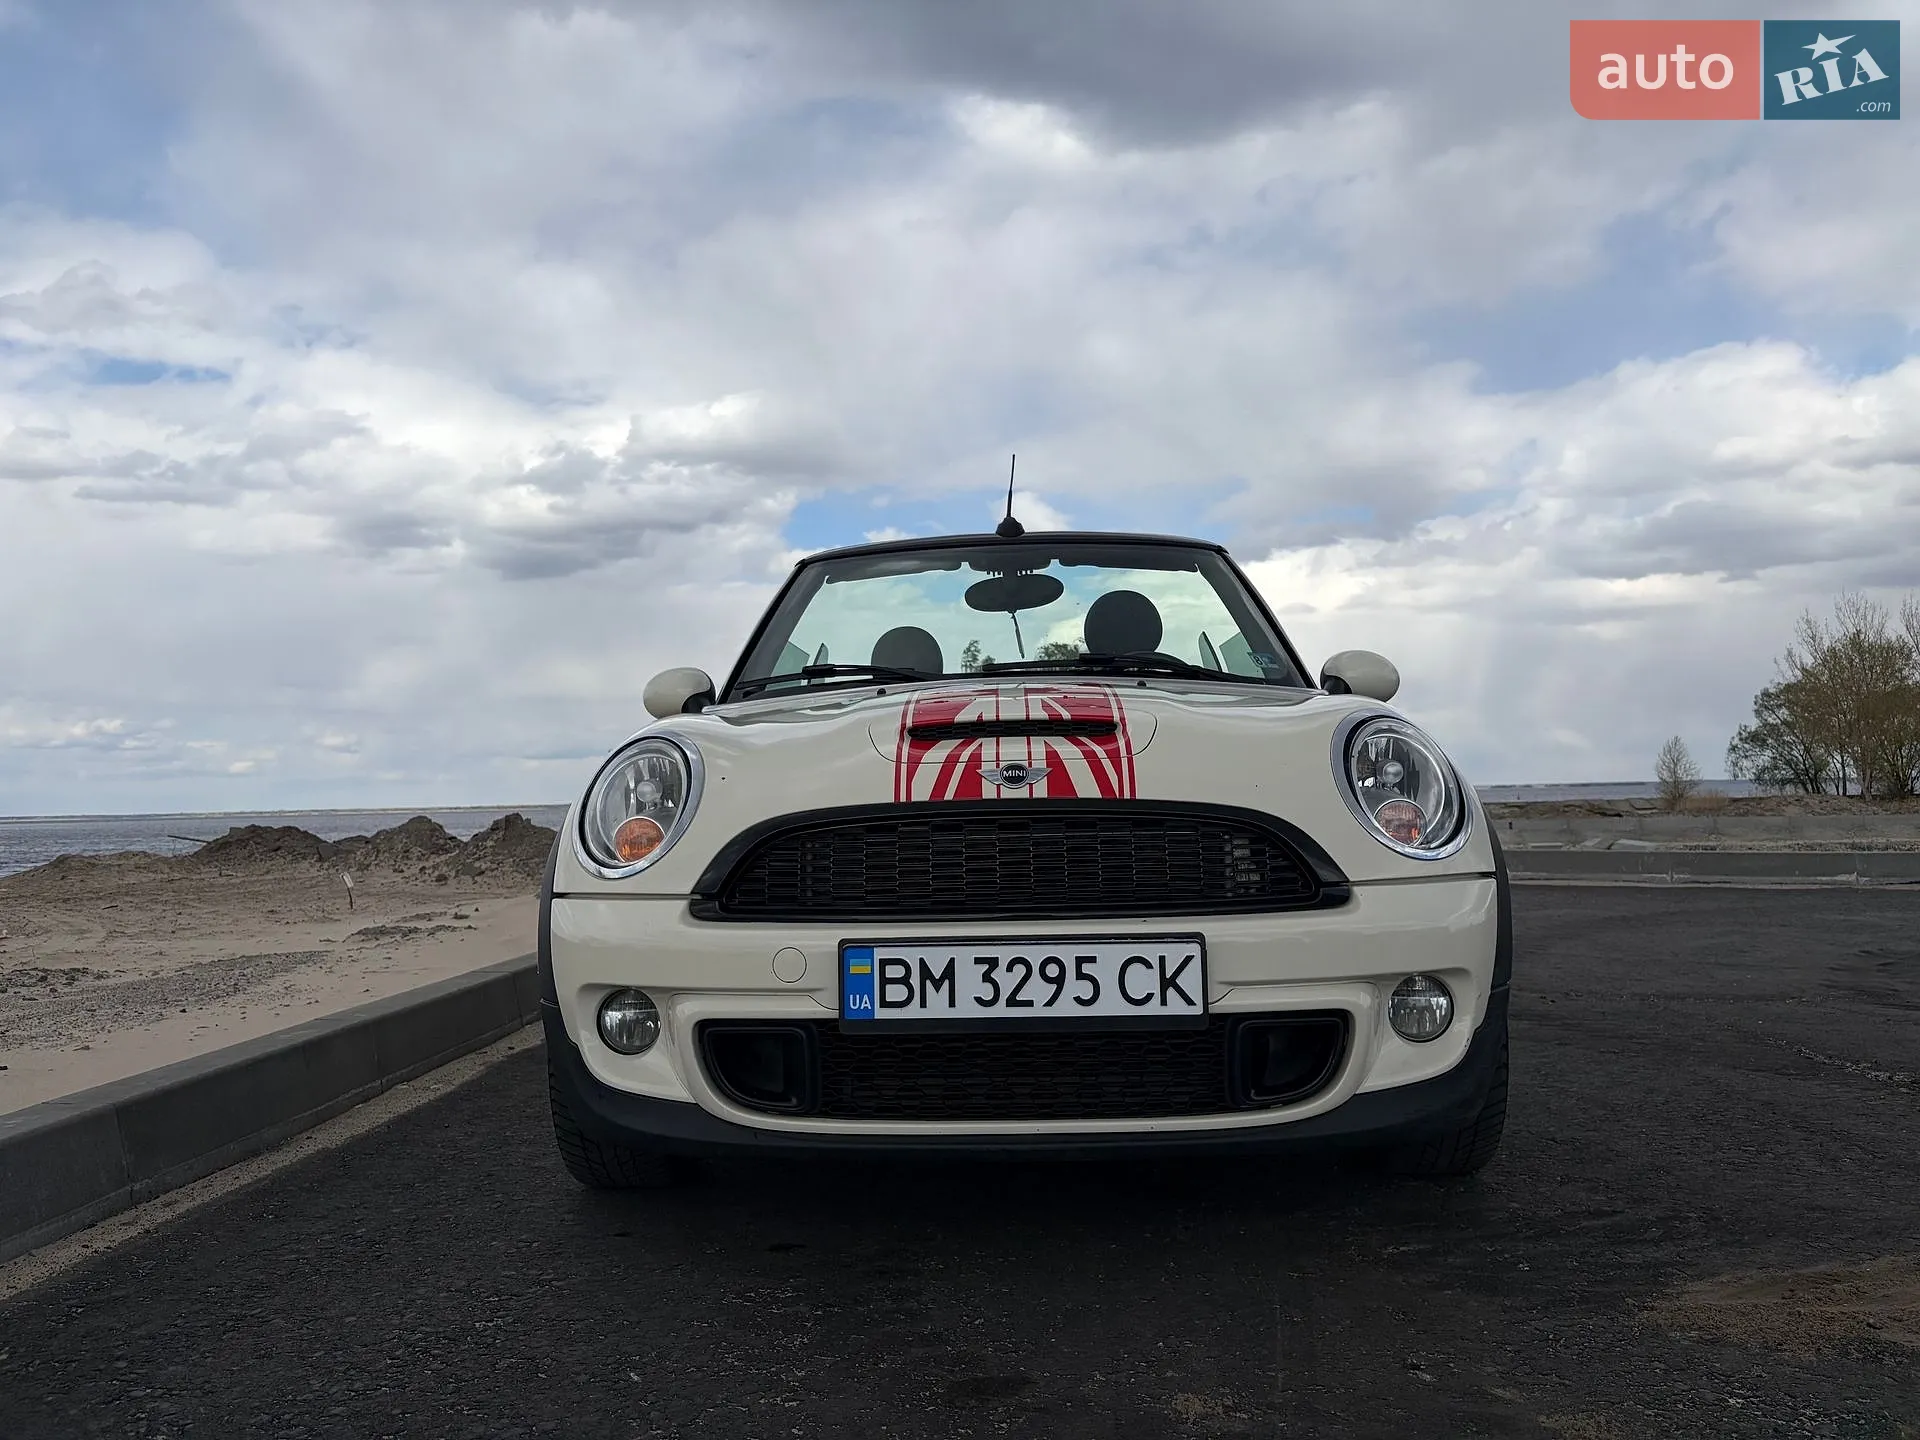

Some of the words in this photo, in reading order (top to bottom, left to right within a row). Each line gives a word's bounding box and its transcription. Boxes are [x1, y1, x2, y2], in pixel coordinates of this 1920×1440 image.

[1003, 770, 1026, 778] MINI
[877, 956, 956, 1010] BM
[972, 955, 1101, 1009] 3295
[1117, 953, 1197, 1008] CK
[849, 993, 872, 1011] UA
